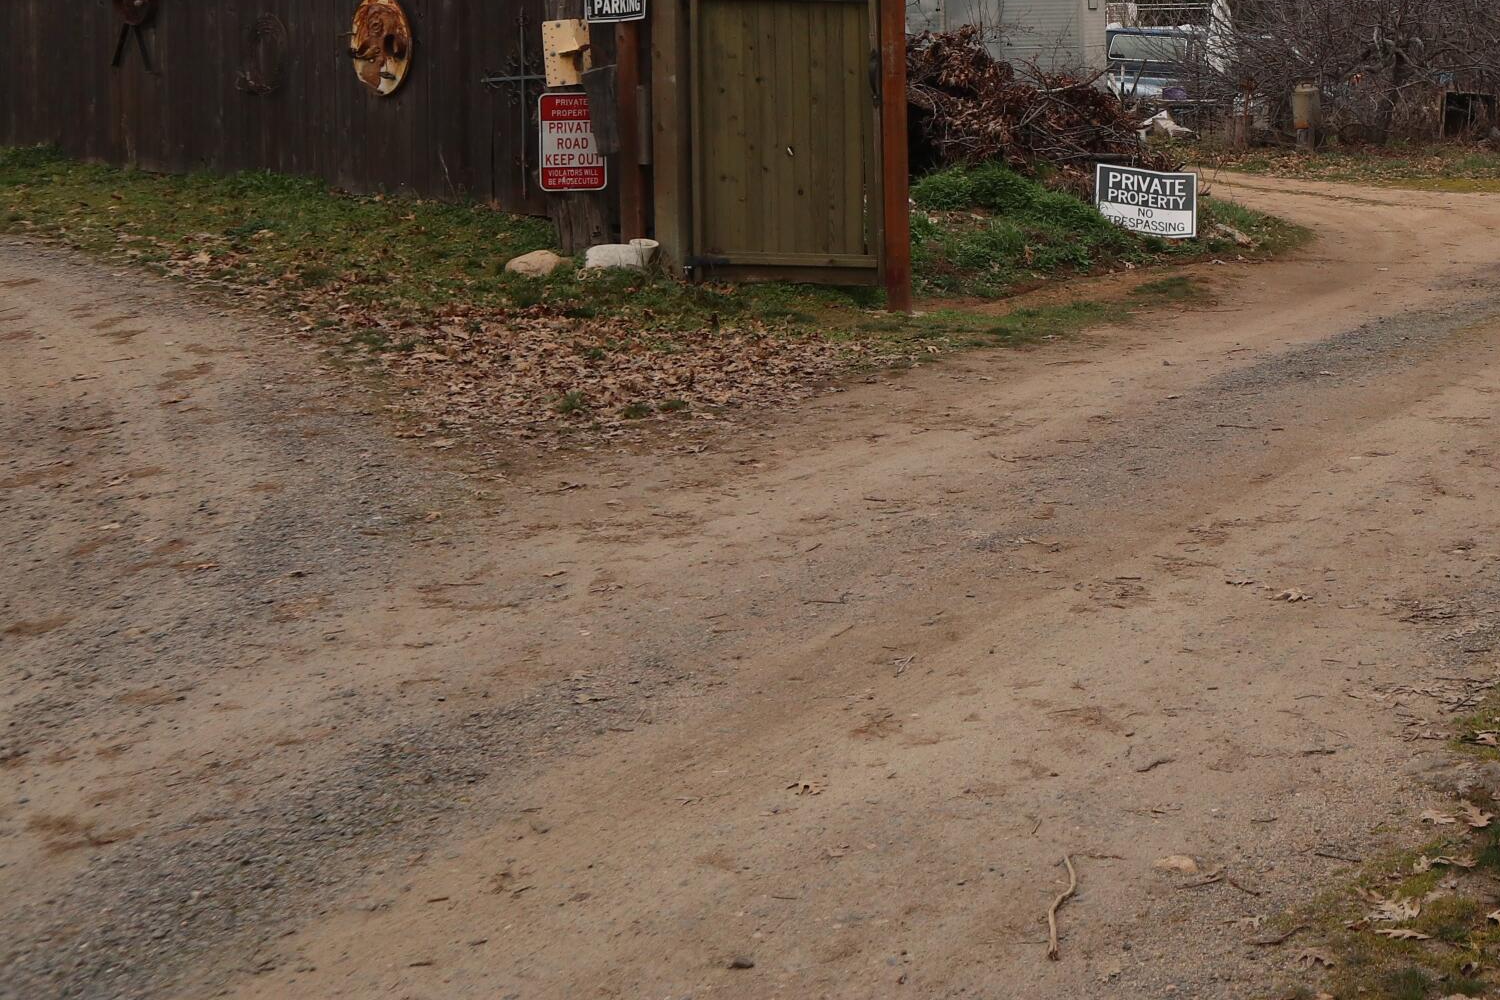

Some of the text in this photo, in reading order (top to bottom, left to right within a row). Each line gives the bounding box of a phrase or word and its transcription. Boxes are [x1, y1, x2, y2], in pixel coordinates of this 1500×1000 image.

[555, 98, 589, 106] PRIVATE
[551, 109, 589, 117] PROPERT
[557, 137, 589, 150] ROAD
[545, 152, 600, 166] KEEP OUT
[548, 168, 599, 177] VIOLATORS WILL
[548, 177, 599, 186] BE PROSECUTED
[1108, 171, 1186, 196] PRIVATE
[1107, 188, 1186, 210] PROPERTY
[1137, 207, 1153, 219] NO
[1106, 214, 1185, 232] TRESPASSING
